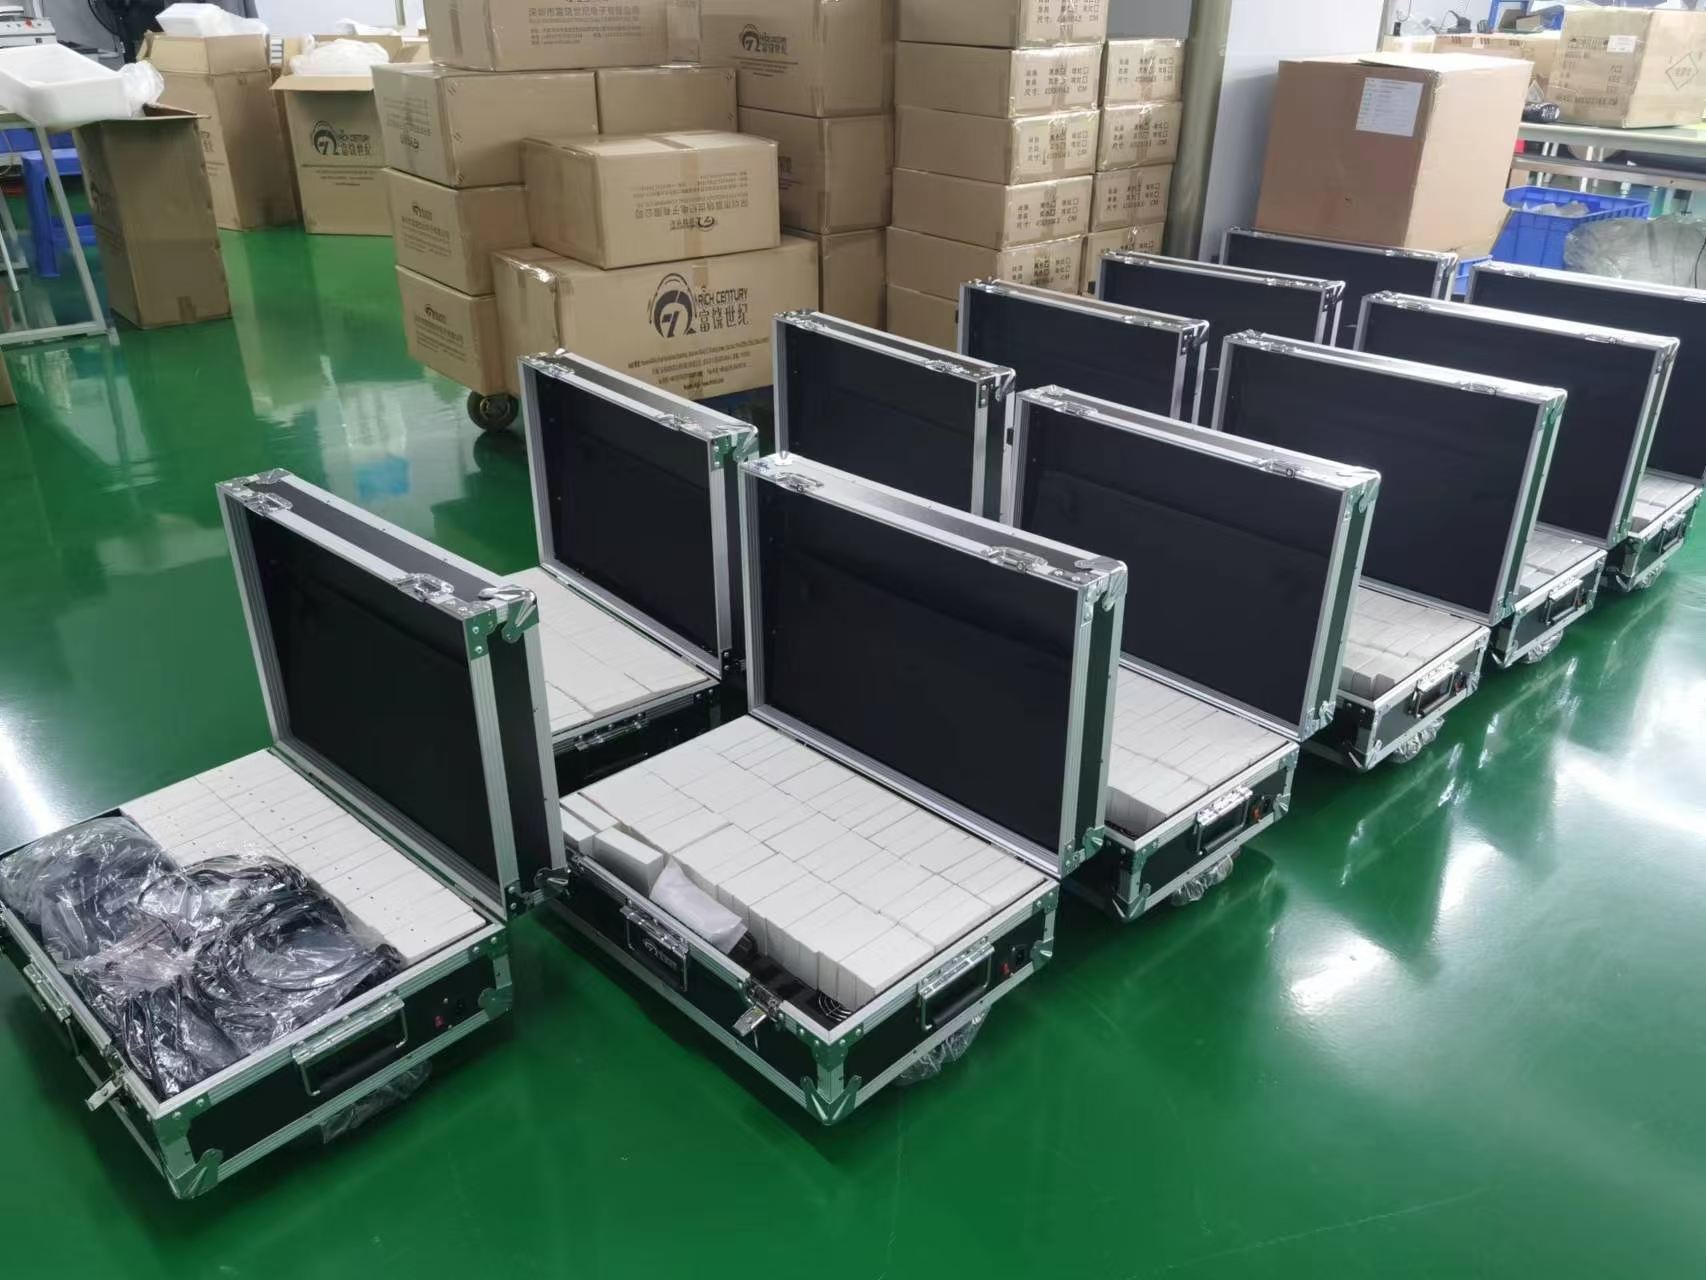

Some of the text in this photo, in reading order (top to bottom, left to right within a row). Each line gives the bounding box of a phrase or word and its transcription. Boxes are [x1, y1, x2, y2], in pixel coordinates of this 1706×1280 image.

[716, 288, 750, 305] CENTURY
[699, 303, 750, 332] 富饶世纪
